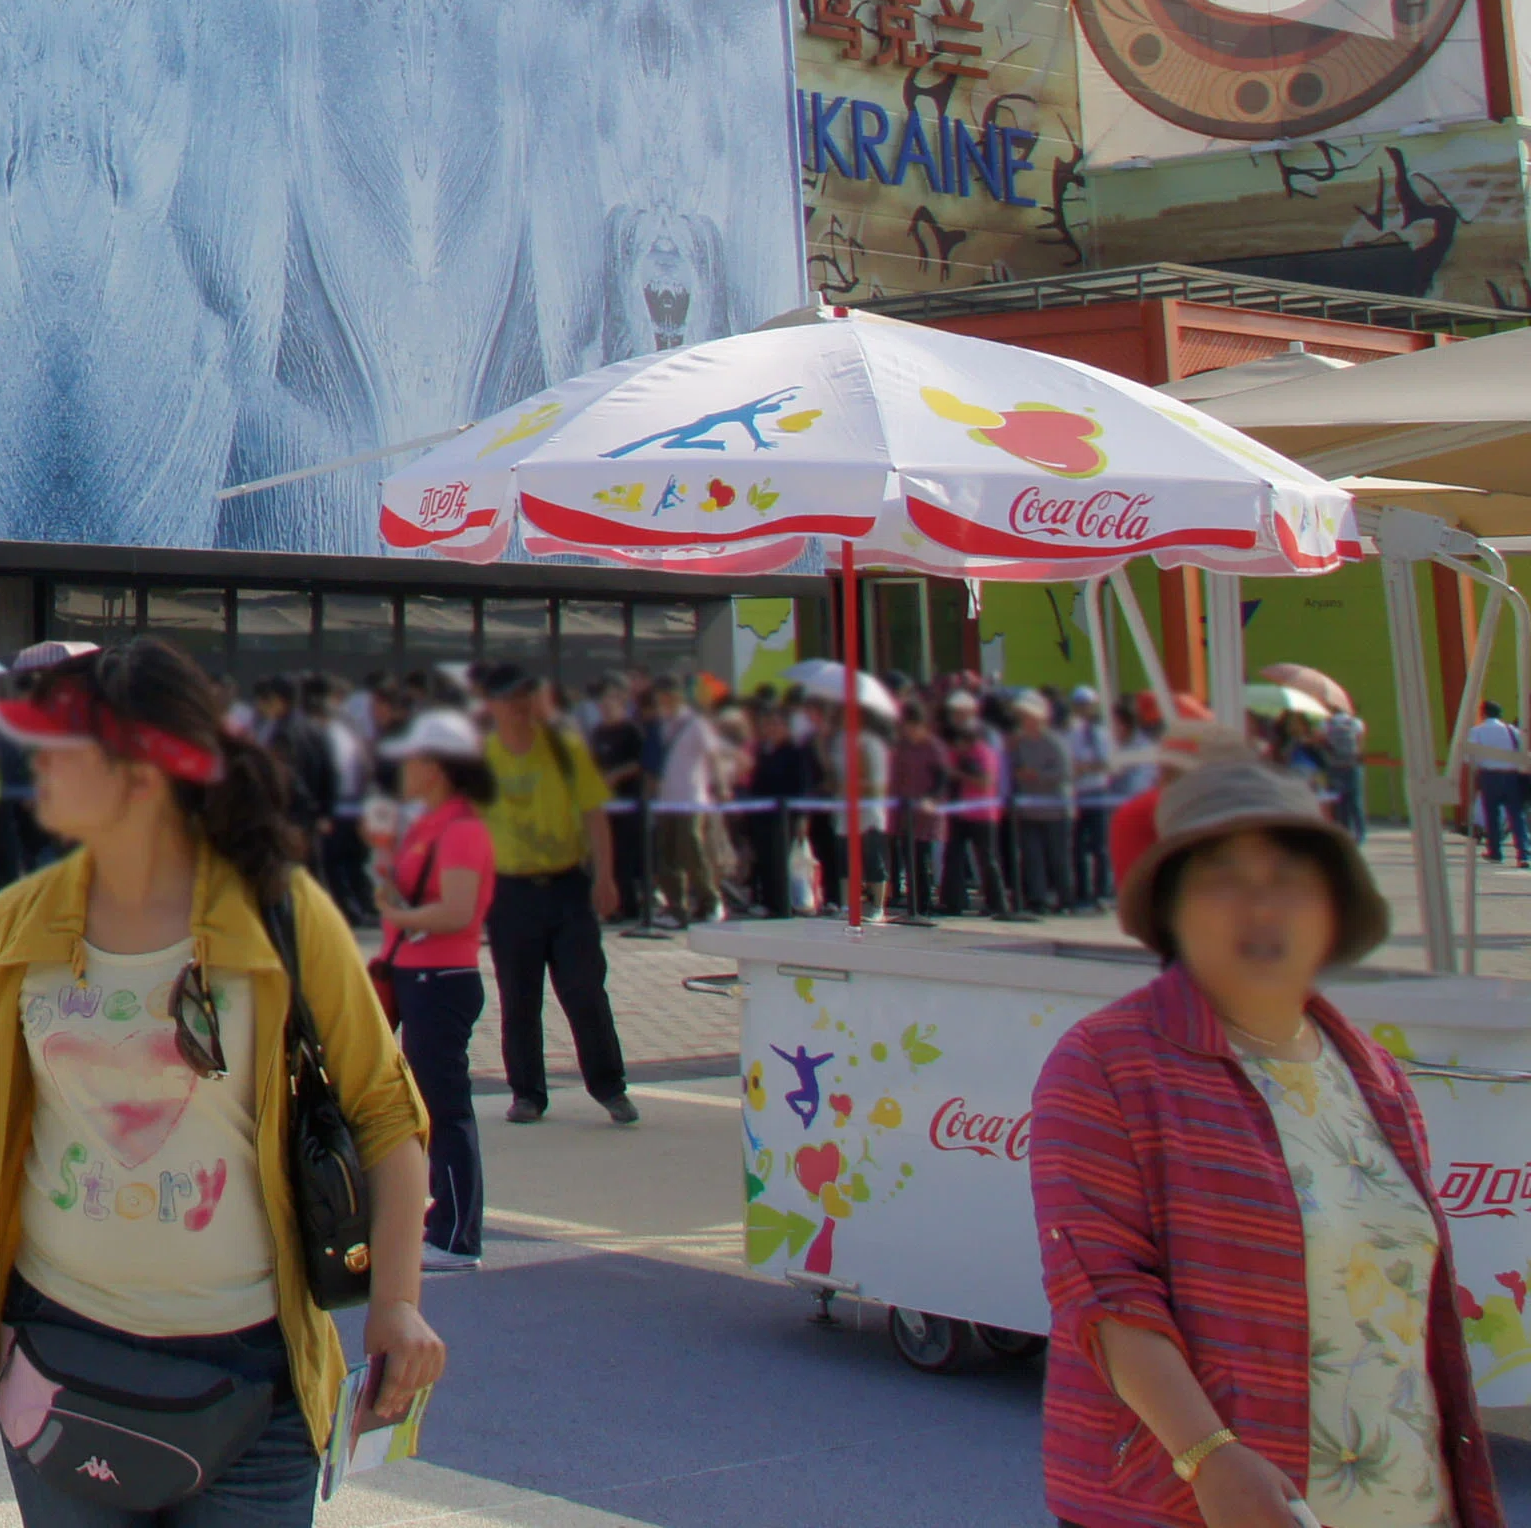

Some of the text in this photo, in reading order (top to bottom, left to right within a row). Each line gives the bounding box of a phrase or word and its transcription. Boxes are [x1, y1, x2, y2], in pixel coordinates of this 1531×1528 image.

[1008, 486, 1155, 540] Coca-Cola
[929, 1096, 1033, 1162] Coca-C
[49, 1141, 227, 1233] Story
[1438, 1162, 1531, 1218] 可口
